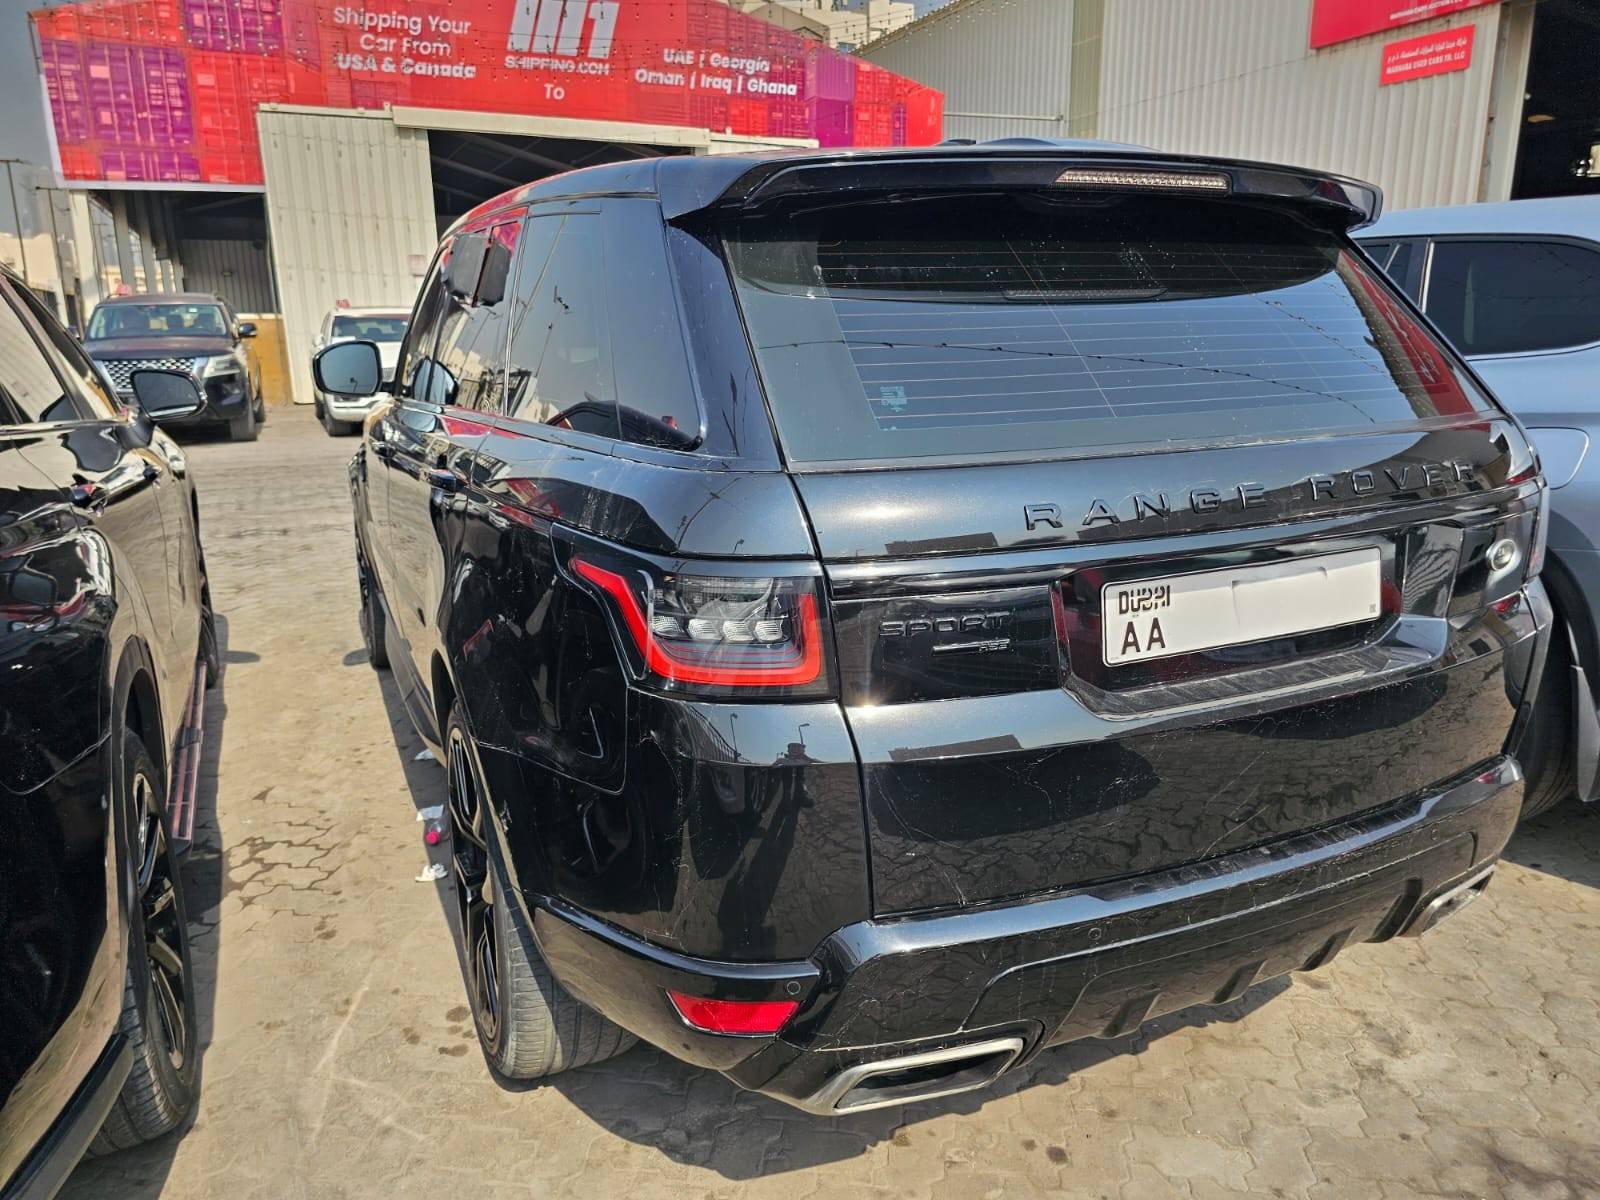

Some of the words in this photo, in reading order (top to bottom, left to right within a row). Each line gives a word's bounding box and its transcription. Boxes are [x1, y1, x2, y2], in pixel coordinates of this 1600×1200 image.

[334, 6, 422, 35] Shipping
[428, 15, 471, 34] Your
[360, 33, 397, 52] Car
[402, 37, 451, 56] From
[337, 52, 378, 72] USA
[381, 57, 396, 73] &
[402, 58, 476, 79] Canada
[663, 48, 695, 65] UAE
[710, 53, 770, 75] Georgia
[544, 83, 565, 100] To
[635, 69, 684, 86] Oman
[701, 74, 732, 94] Iraq
[747, 78, 798, 96] Ghana
[1023, 482, 1267, 531] RANGE
[1310, 460, 1475, 501] ROVER
[879, 611, 1010, 637] SPORT
[1121, 617, 1166, 655] AA
